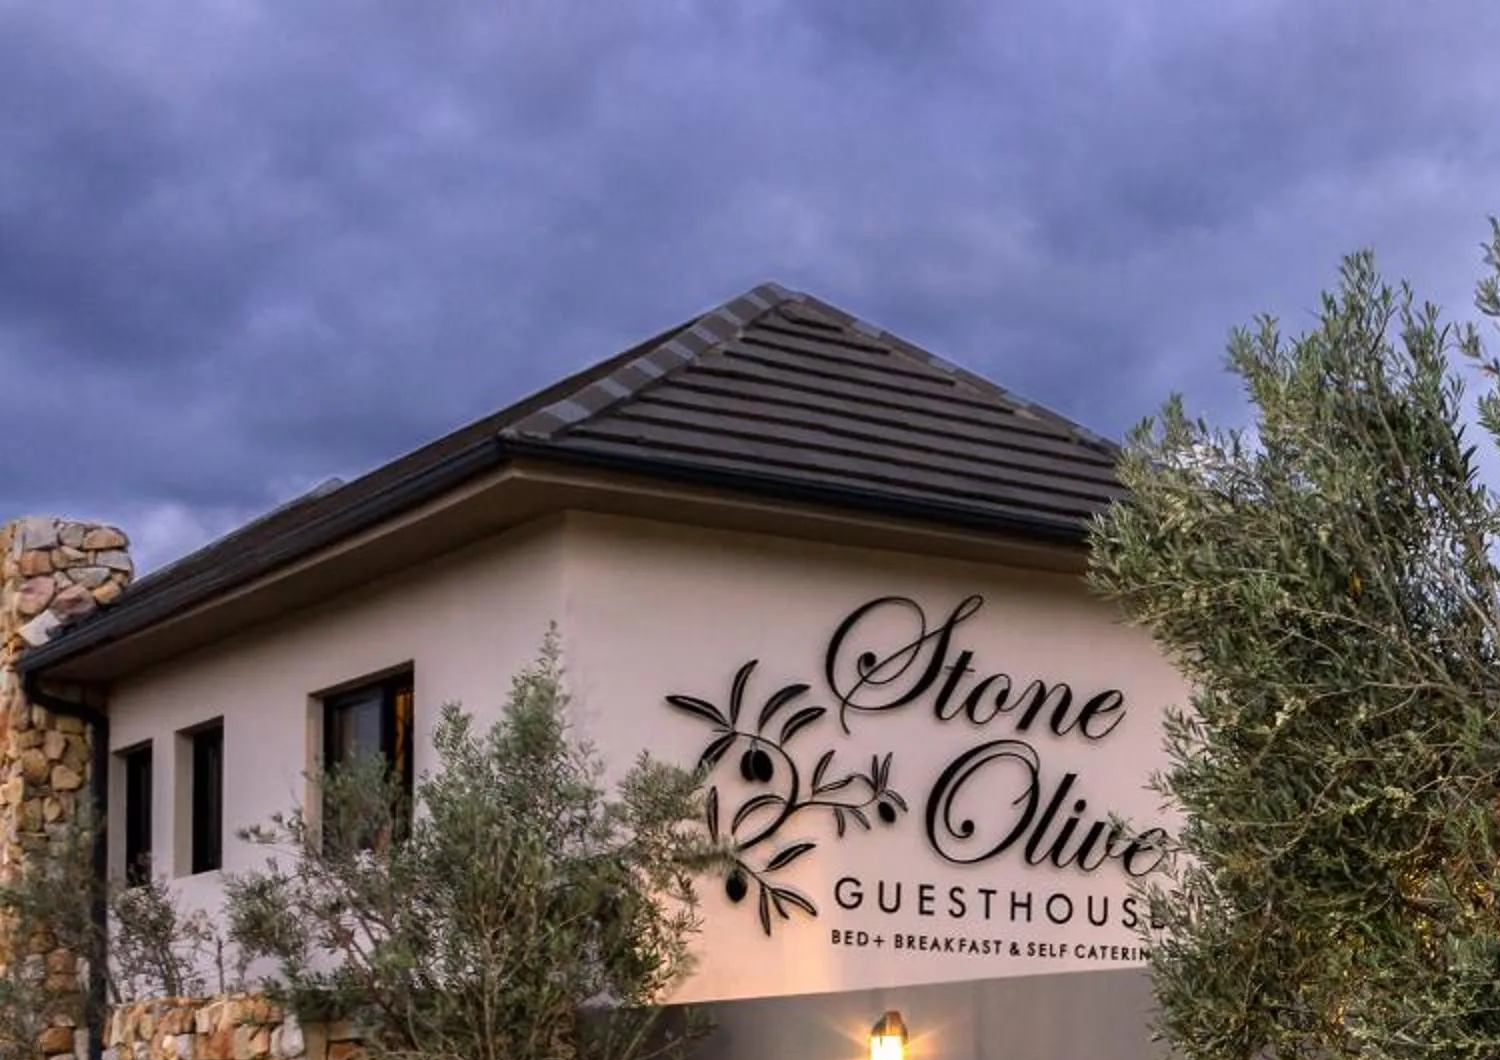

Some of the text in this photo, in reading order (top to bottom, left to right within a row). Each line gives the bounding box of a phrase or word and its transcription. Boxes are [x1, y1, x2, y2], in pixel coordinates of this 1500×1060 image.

[825, 594, 1127, 741] Stone
[926, 739, 1167, 877] Olive
[834, 876, 1165, 929] GUESTHOUS
[894, 933, 1002, 955] BREAKFAST
[1009, 941, 1021, 958] &
[1027, 942, 1068, 959] SELF
[1074, 943, 1152, 961] CATERIN
